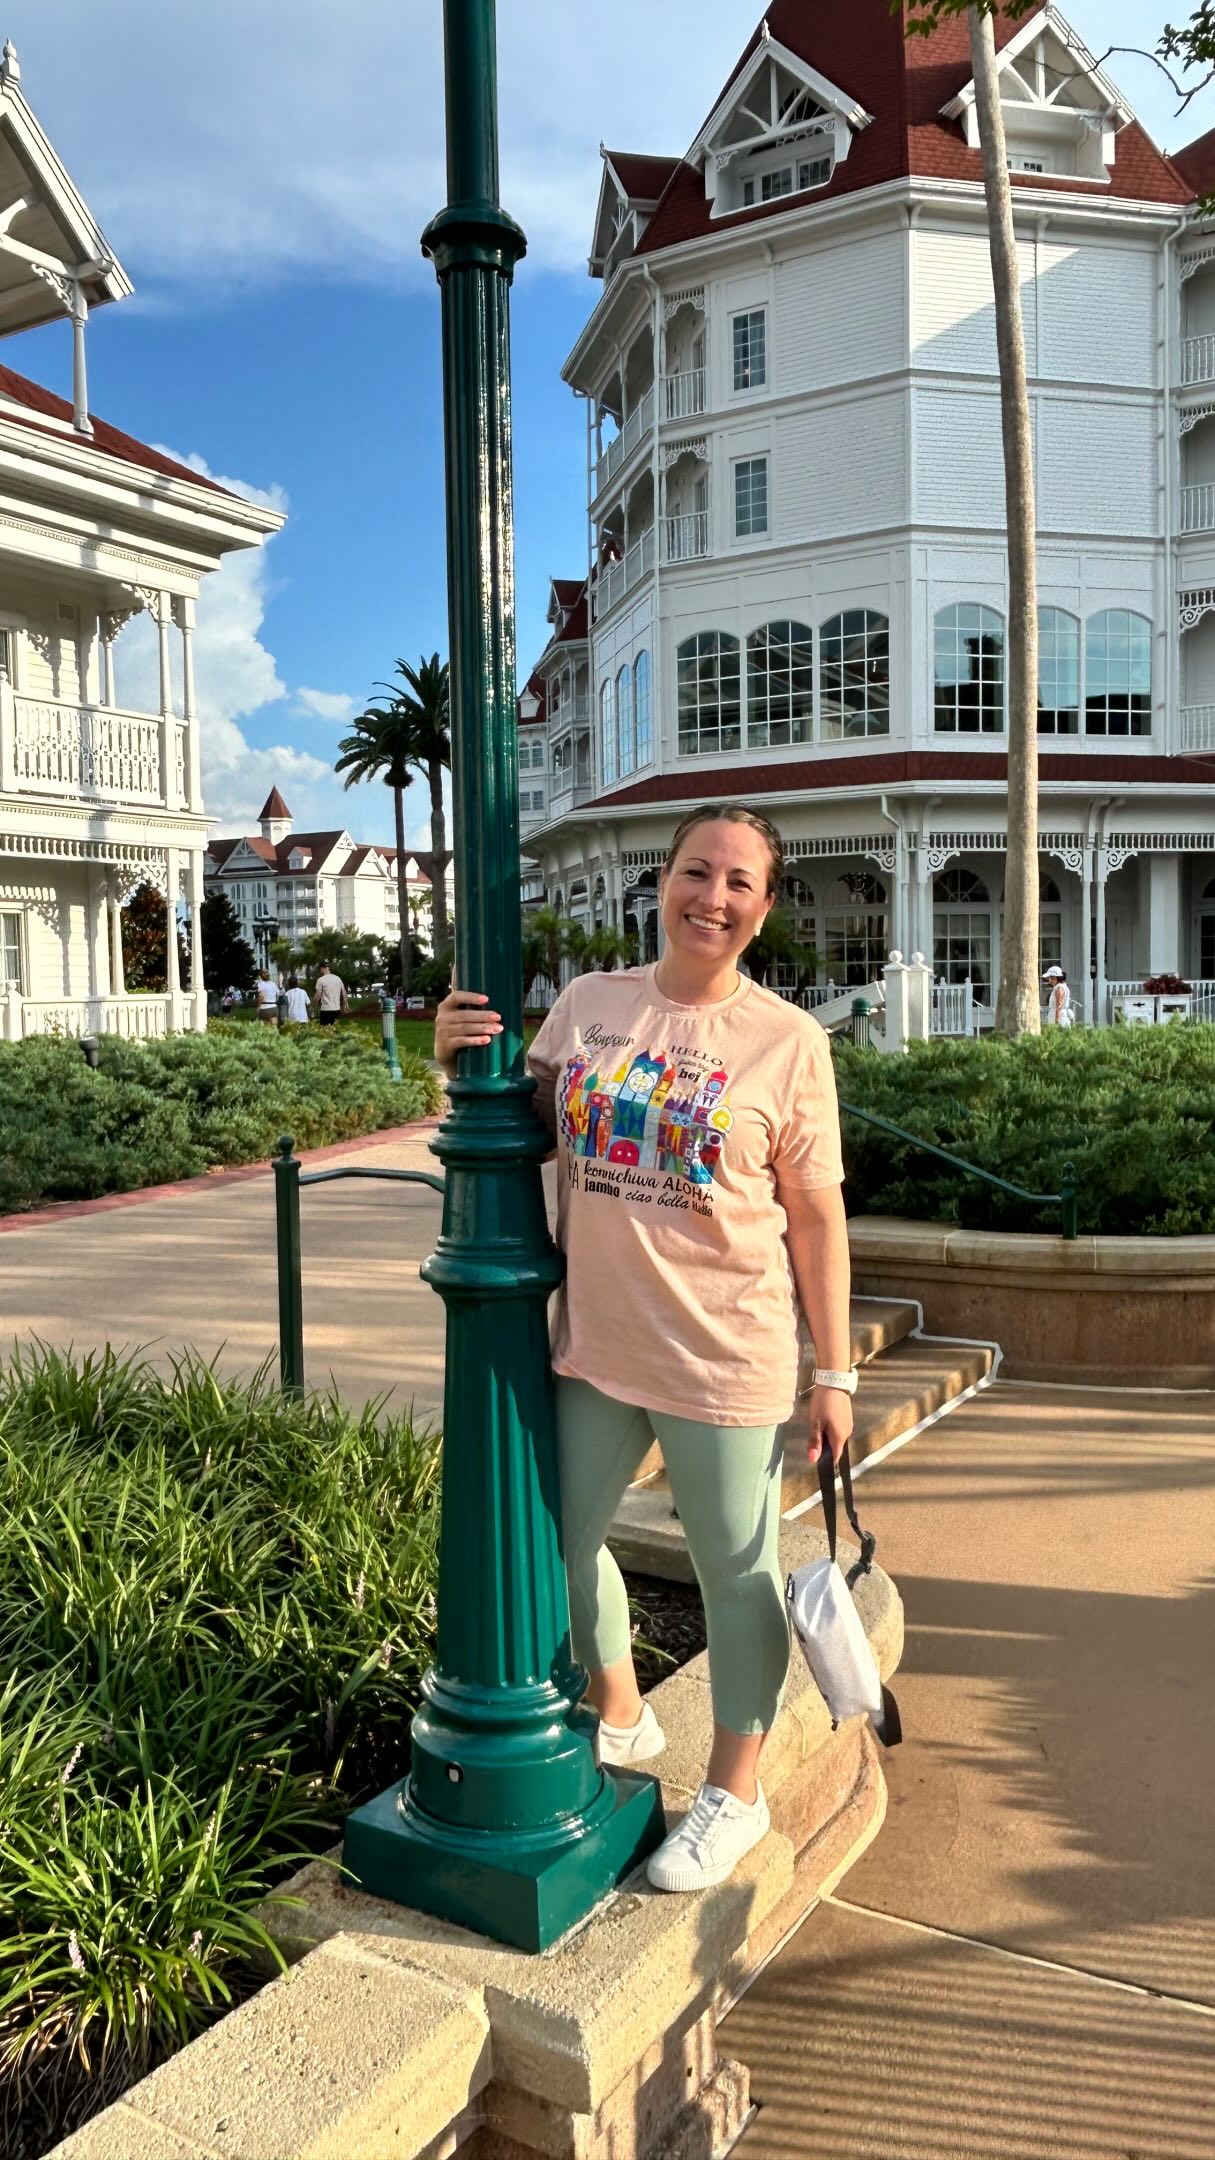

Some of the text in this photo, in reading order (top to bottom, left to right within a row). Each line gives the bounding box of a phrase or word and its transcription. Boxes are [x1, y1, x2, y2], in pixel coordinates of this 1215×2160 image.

[584, 1024, 635, 1049] Bonjour
[671, 1045, 723, 1065] HELLO
[678, 1068, 701, 1083] hej
[663, 1177, 714, 1202] ALOHA
[625, 1190, 652, 1203] ciao
[657, 1192, 689, 1210] bella
